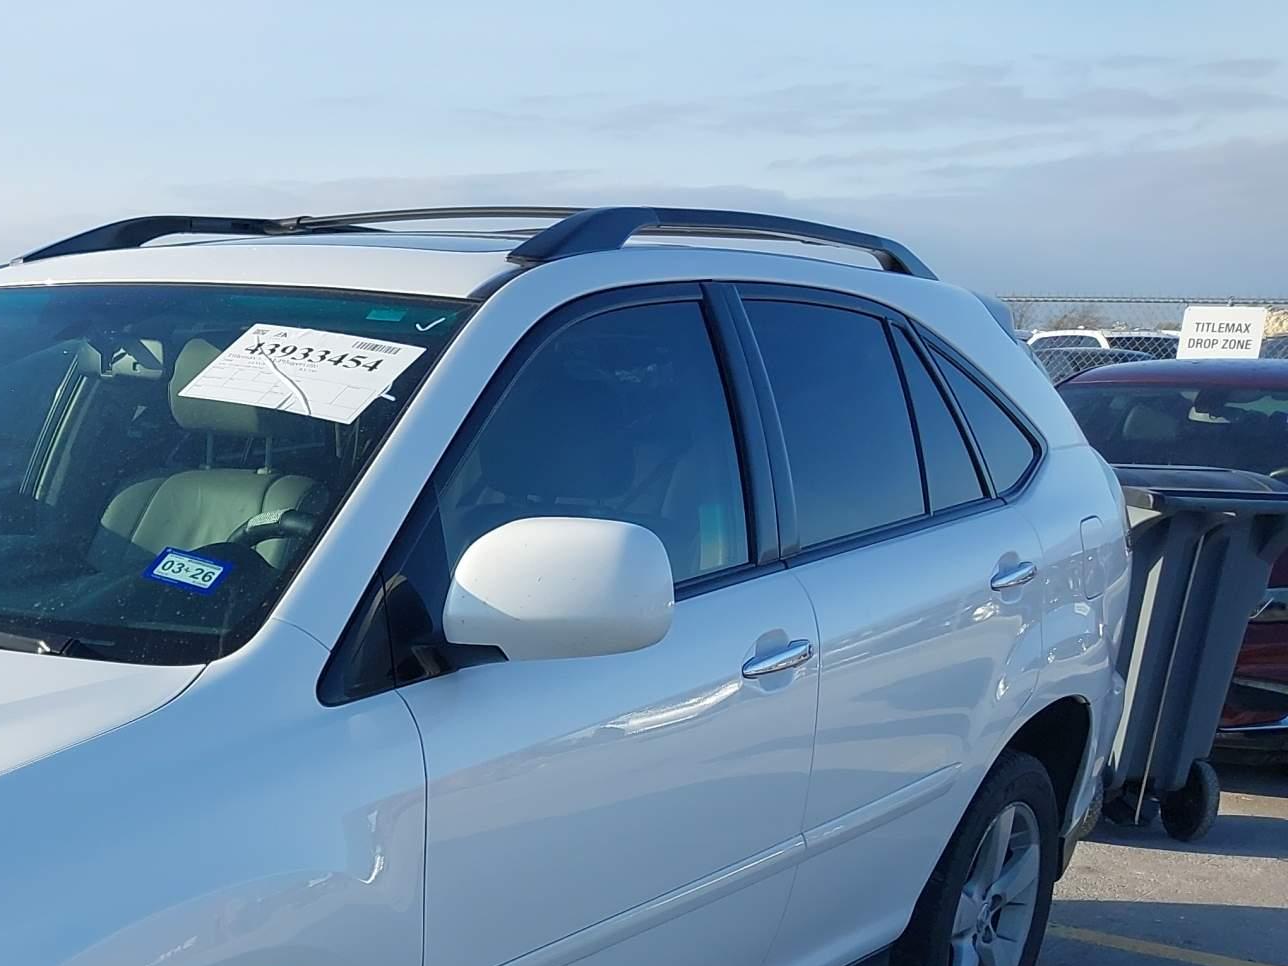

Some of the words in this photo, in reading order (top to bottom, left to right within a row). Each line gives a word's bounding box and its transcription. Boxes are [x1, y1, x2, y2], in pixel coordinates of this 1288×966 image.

[1194, 322, 1252, 334] TITLEMAX
[1187, 338, 1218, 350] DROP
[1221, 338, 1253, 350] ZONE
[244, 341, 384, 372] 43933454
